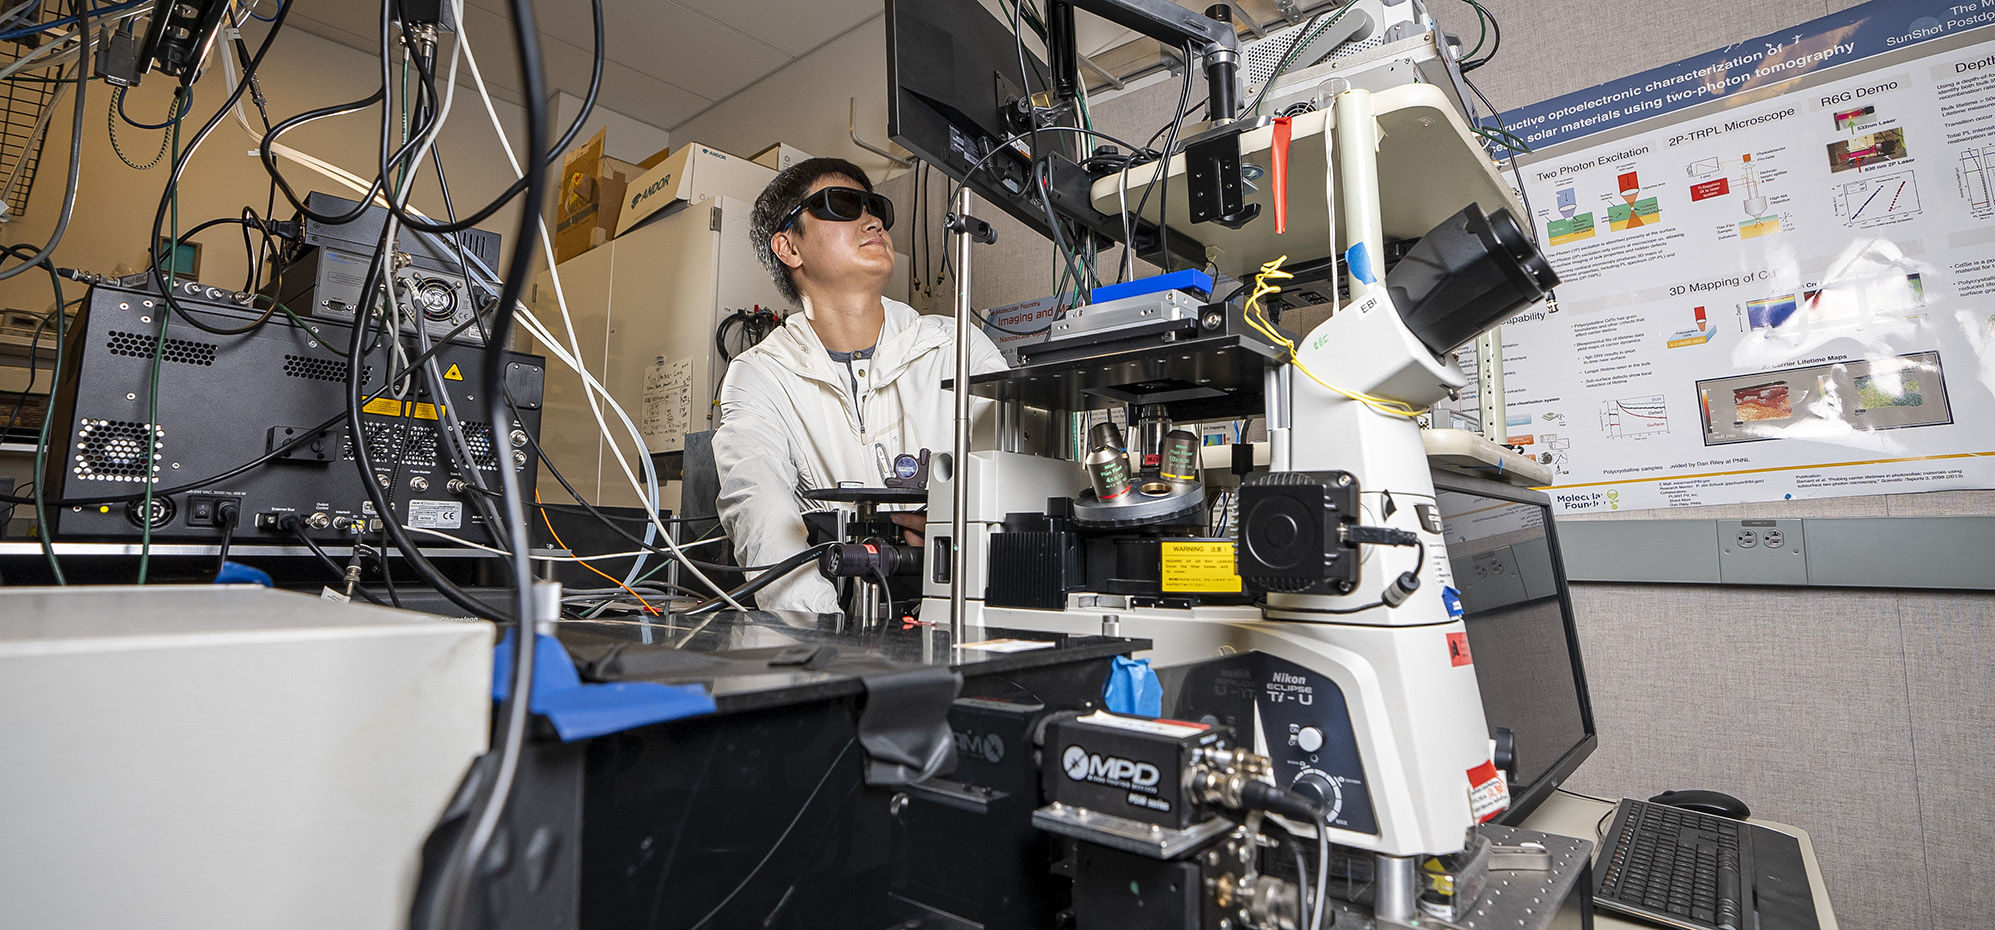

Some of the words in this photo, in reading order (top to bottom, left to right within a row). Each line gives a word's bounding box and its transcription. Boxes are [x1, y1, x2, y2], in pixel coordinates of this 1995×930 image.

[1950, 3, 1977, 16] The
[1886, 24, 1944, 46] SunShot
[1548, 86, 1642, 121] optoelectronic
[1645, 50, 1763, 92] characterization
[1767, 41, 1784, 57] of
[1527, 127, 1558, 143] solar
[1561, 109, 1621, 134] materials
[1624, 96, 1663, 116] using
[1666, 72, 1751, 103] two-photon
[1754, 42, 1855, 78] tomography
[1821, 91, 1852, 107] R6G
[1855, 80, 1898, 99] Demo
[1939, 87, 1982, 101] recombination
[1956, 101, 1978, 109] lifetime
[1668, 126, 1722, 147] 2P-TRPL
[1724, 107, 1795, 132] Microscope
[1879, 118, 1896, 126] Laser
[1944, 119, 1975, 127] Transition
[1947, 132, 1987, 145] reabsorption
[708, 151, 727, 160] ANDOR
[1897, 157, 1915, 165] Laser
[1537, 171, 1557, 180] Two
[1559, 160, 1595, 175] Photon
[1598, 145, 1649, 165] Excitation
[640, 173, 671, 203] ANDOR
[1955, 265, 1980, 274] material
[1670, 286, 1685, 296] 3D
[1689, 276, 1740, 293] Mapping
[1743, 273, 1754, 282] of
[1958, 283, 1984, 292] reduced
[995, 304, 1019, 315] Molecular
[1020, 301, 1040, 309] Foundry
[1360, 297, 1378, 314] EBI
[998, 312, 1033, 327] Imaging
[1036, 306, 1053, 319] and
[1797, 357, 1826, 366] Lifetime
[1828, 354, 1847, 363] Maps
[1603, 467, 1640, 475] Polycrystalline
[1272, 672, 1306, 685] Nikon
[1266, 682, 1313, 694] ECLIPSE
[1089, 753, 1160, 786] MPD
